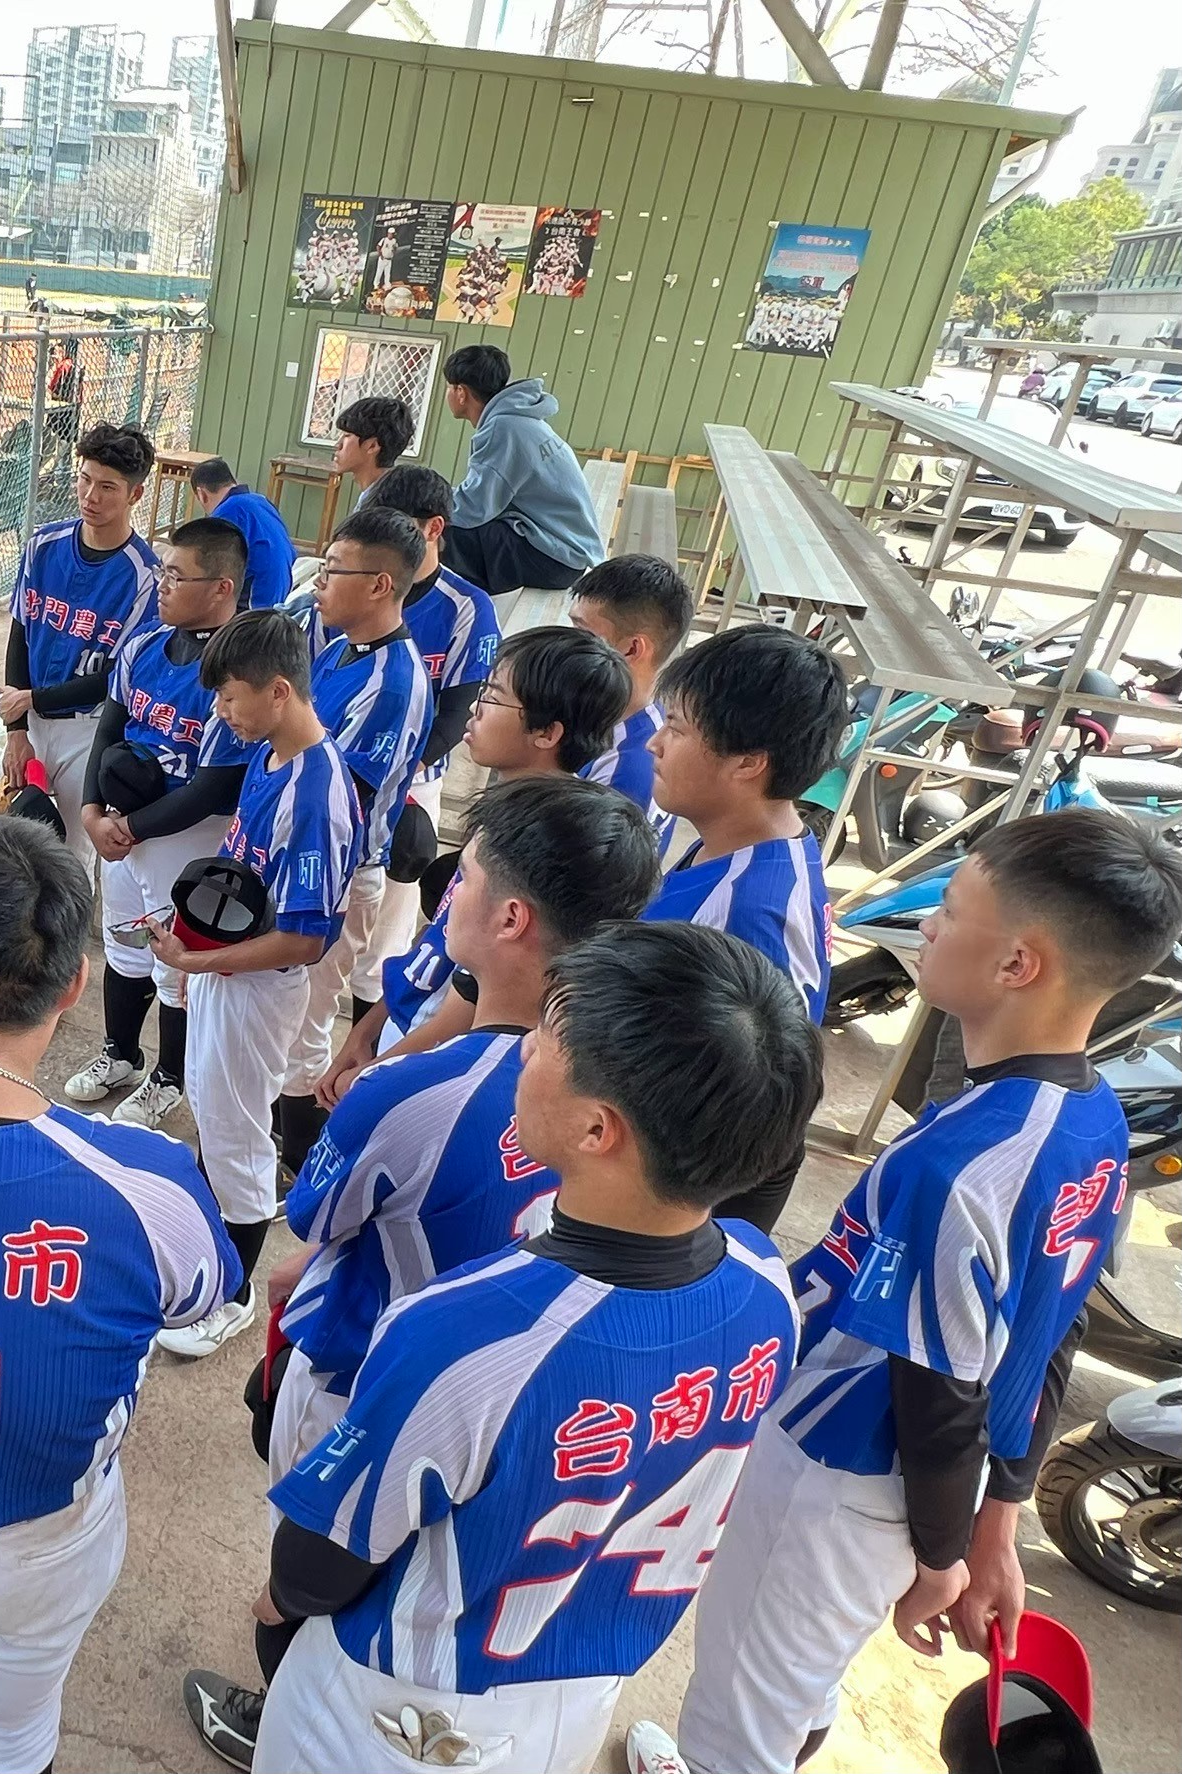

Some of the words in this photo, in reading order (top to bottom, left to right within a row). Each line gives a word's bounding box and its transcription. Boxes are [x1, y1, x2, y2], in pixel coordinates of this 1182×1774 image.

[74, 648, 105, 677] 10
[128, 688, 204, 747] 門農工
[402, 942, 441, 992] 11
[553, 1337, 781, 1482] 台南市
